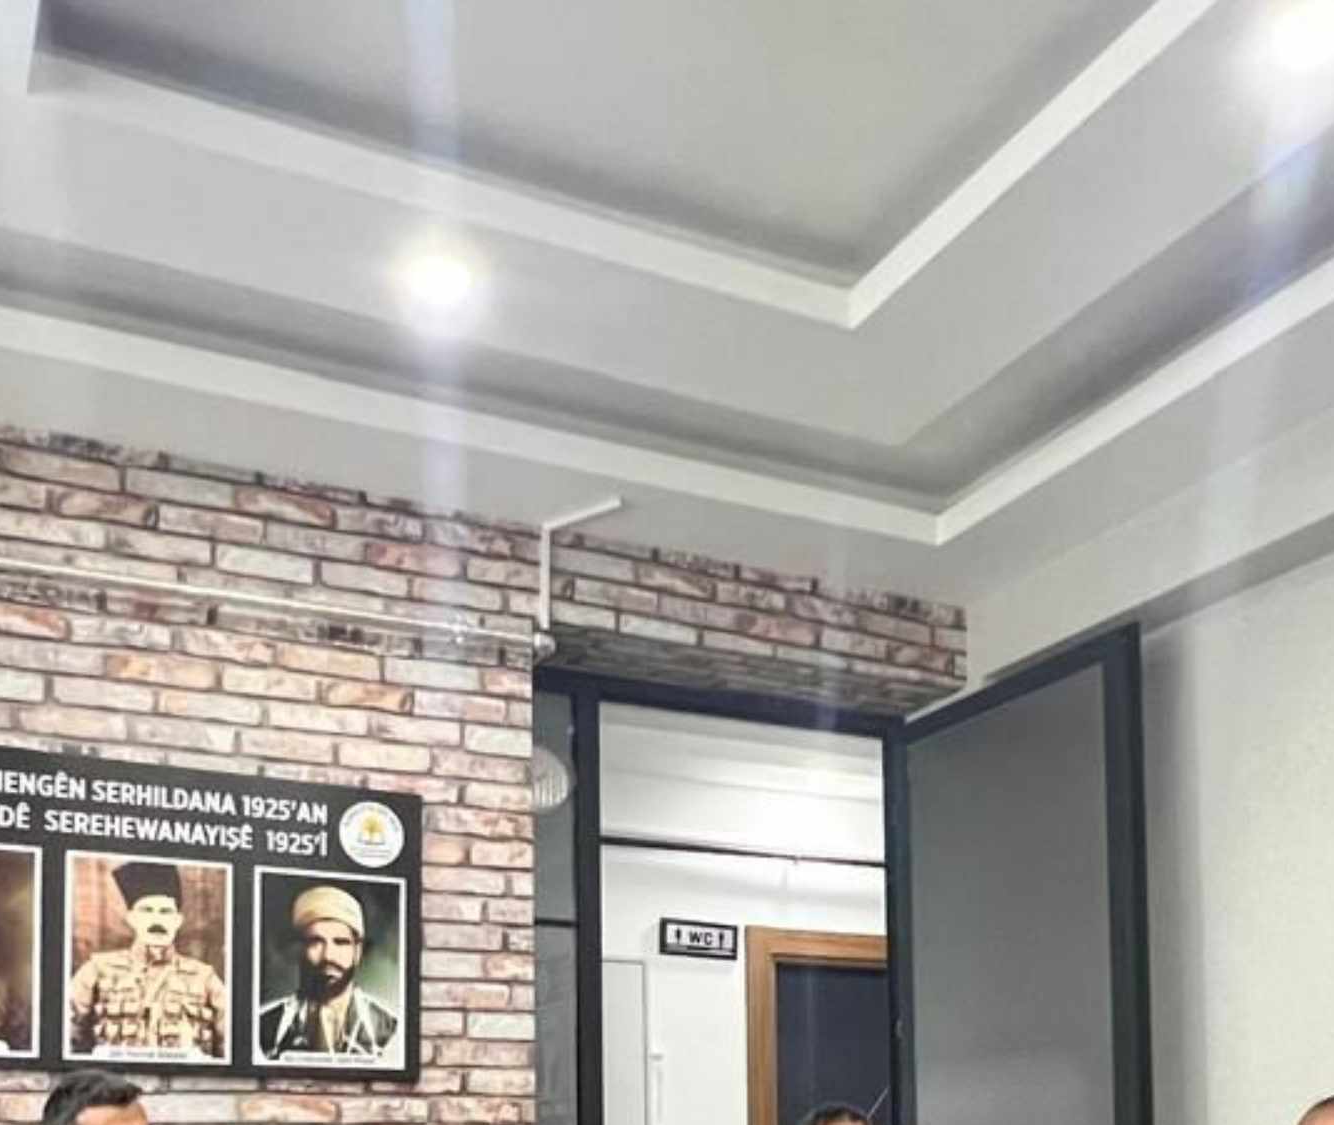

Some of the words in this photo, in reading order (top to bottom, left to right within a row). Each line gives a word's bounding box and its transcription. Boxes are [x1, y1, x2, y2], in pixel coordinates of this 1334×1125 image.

[91, 779, 236, 817] SERHILDANA
[241, 794, 328, 825] 1925'AN
[44, 809, 253, 851] SEREHEWANAYIŞÊ
[689, 931, 713, 945] WC
